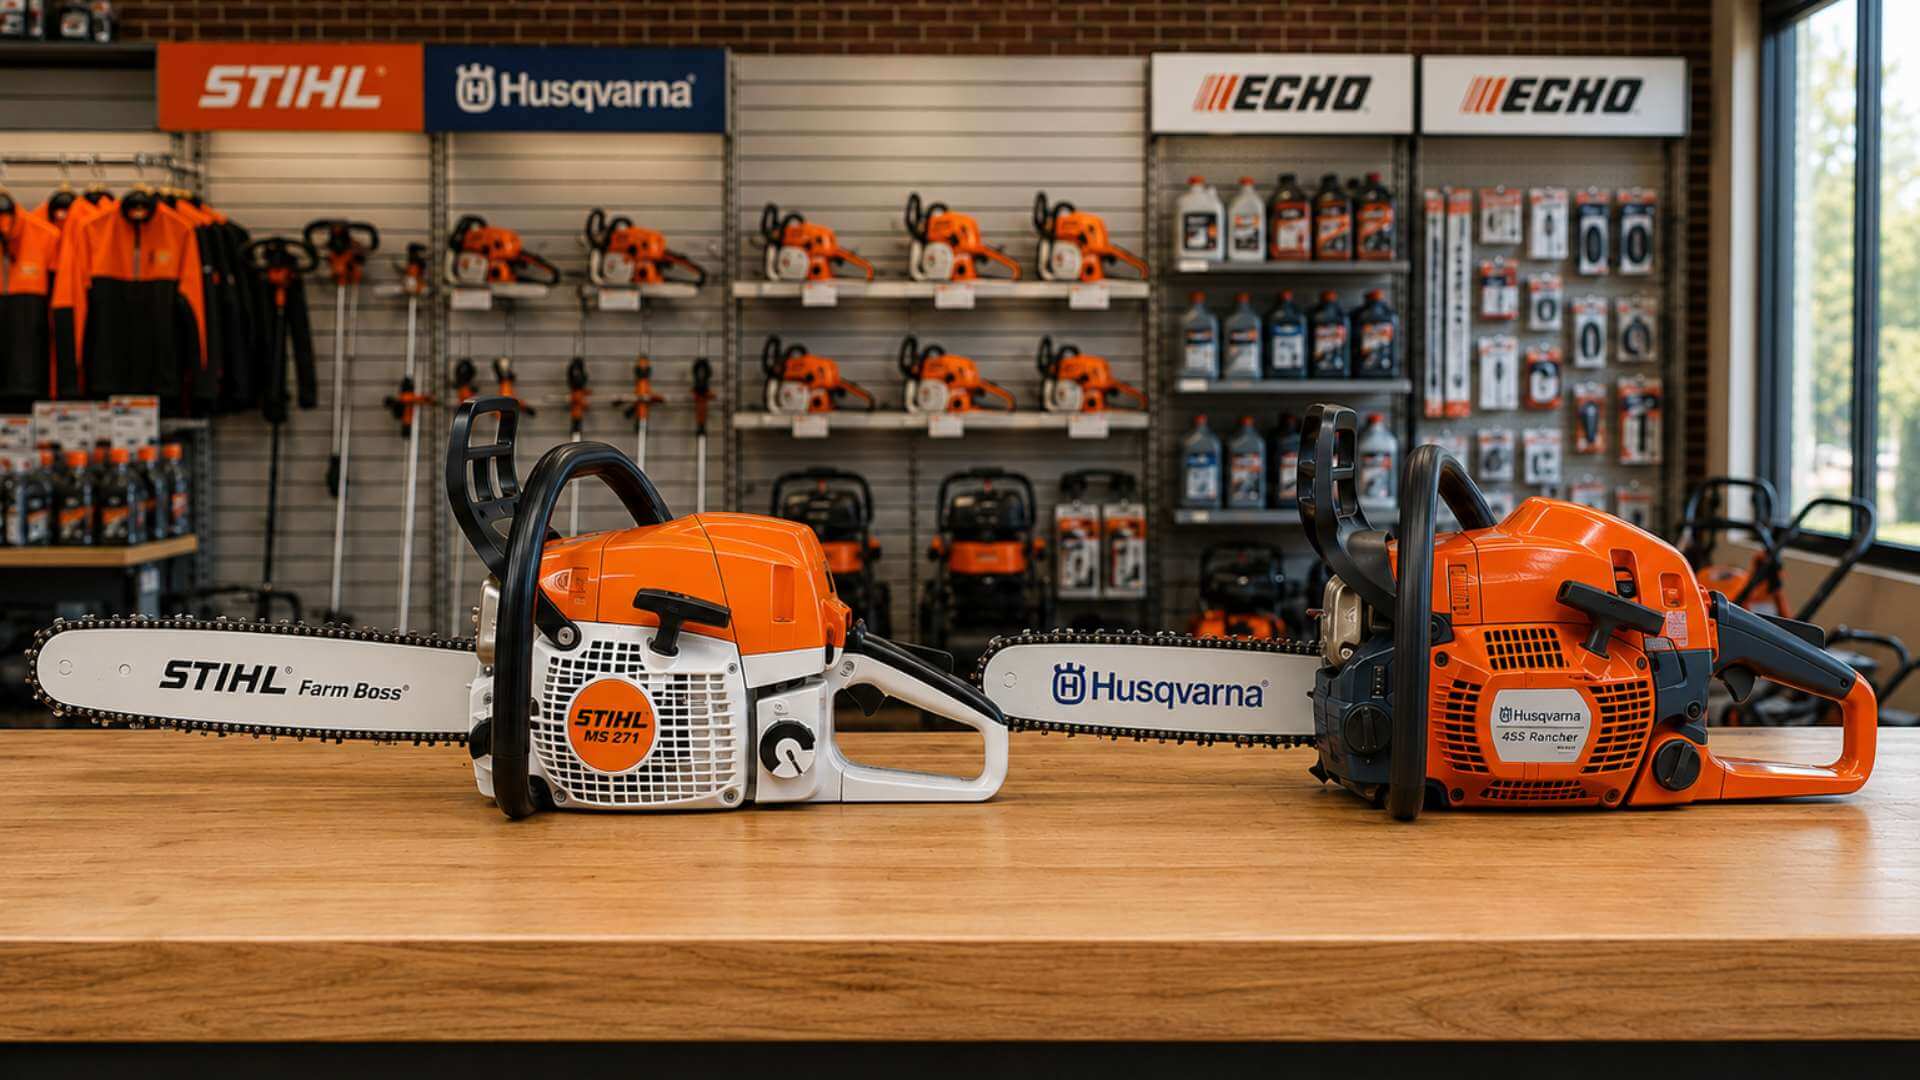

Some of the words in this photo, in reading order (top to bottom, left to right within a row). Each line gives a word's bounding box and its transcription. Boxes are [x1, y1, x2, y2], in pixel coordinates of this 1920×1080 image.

[198, 64, 381, 109] STIHL
[500, 72, 692, 113] Husqvarna
[1233, 75, 1372, 111] ECHO
[1500, 77, 1643, 113] ECHO
[299, 680, 349, 698] Farm
[1091, 671, 1263, 709] Husqvarna
[574, 709, 648, 729] STIHL
[1514, 709, 1581, 723] Husqvarna
[584, 730, 609, 743] MS
[612, 731, 640, 744] 271
[1529, 731, 1579, 742] Rancher
